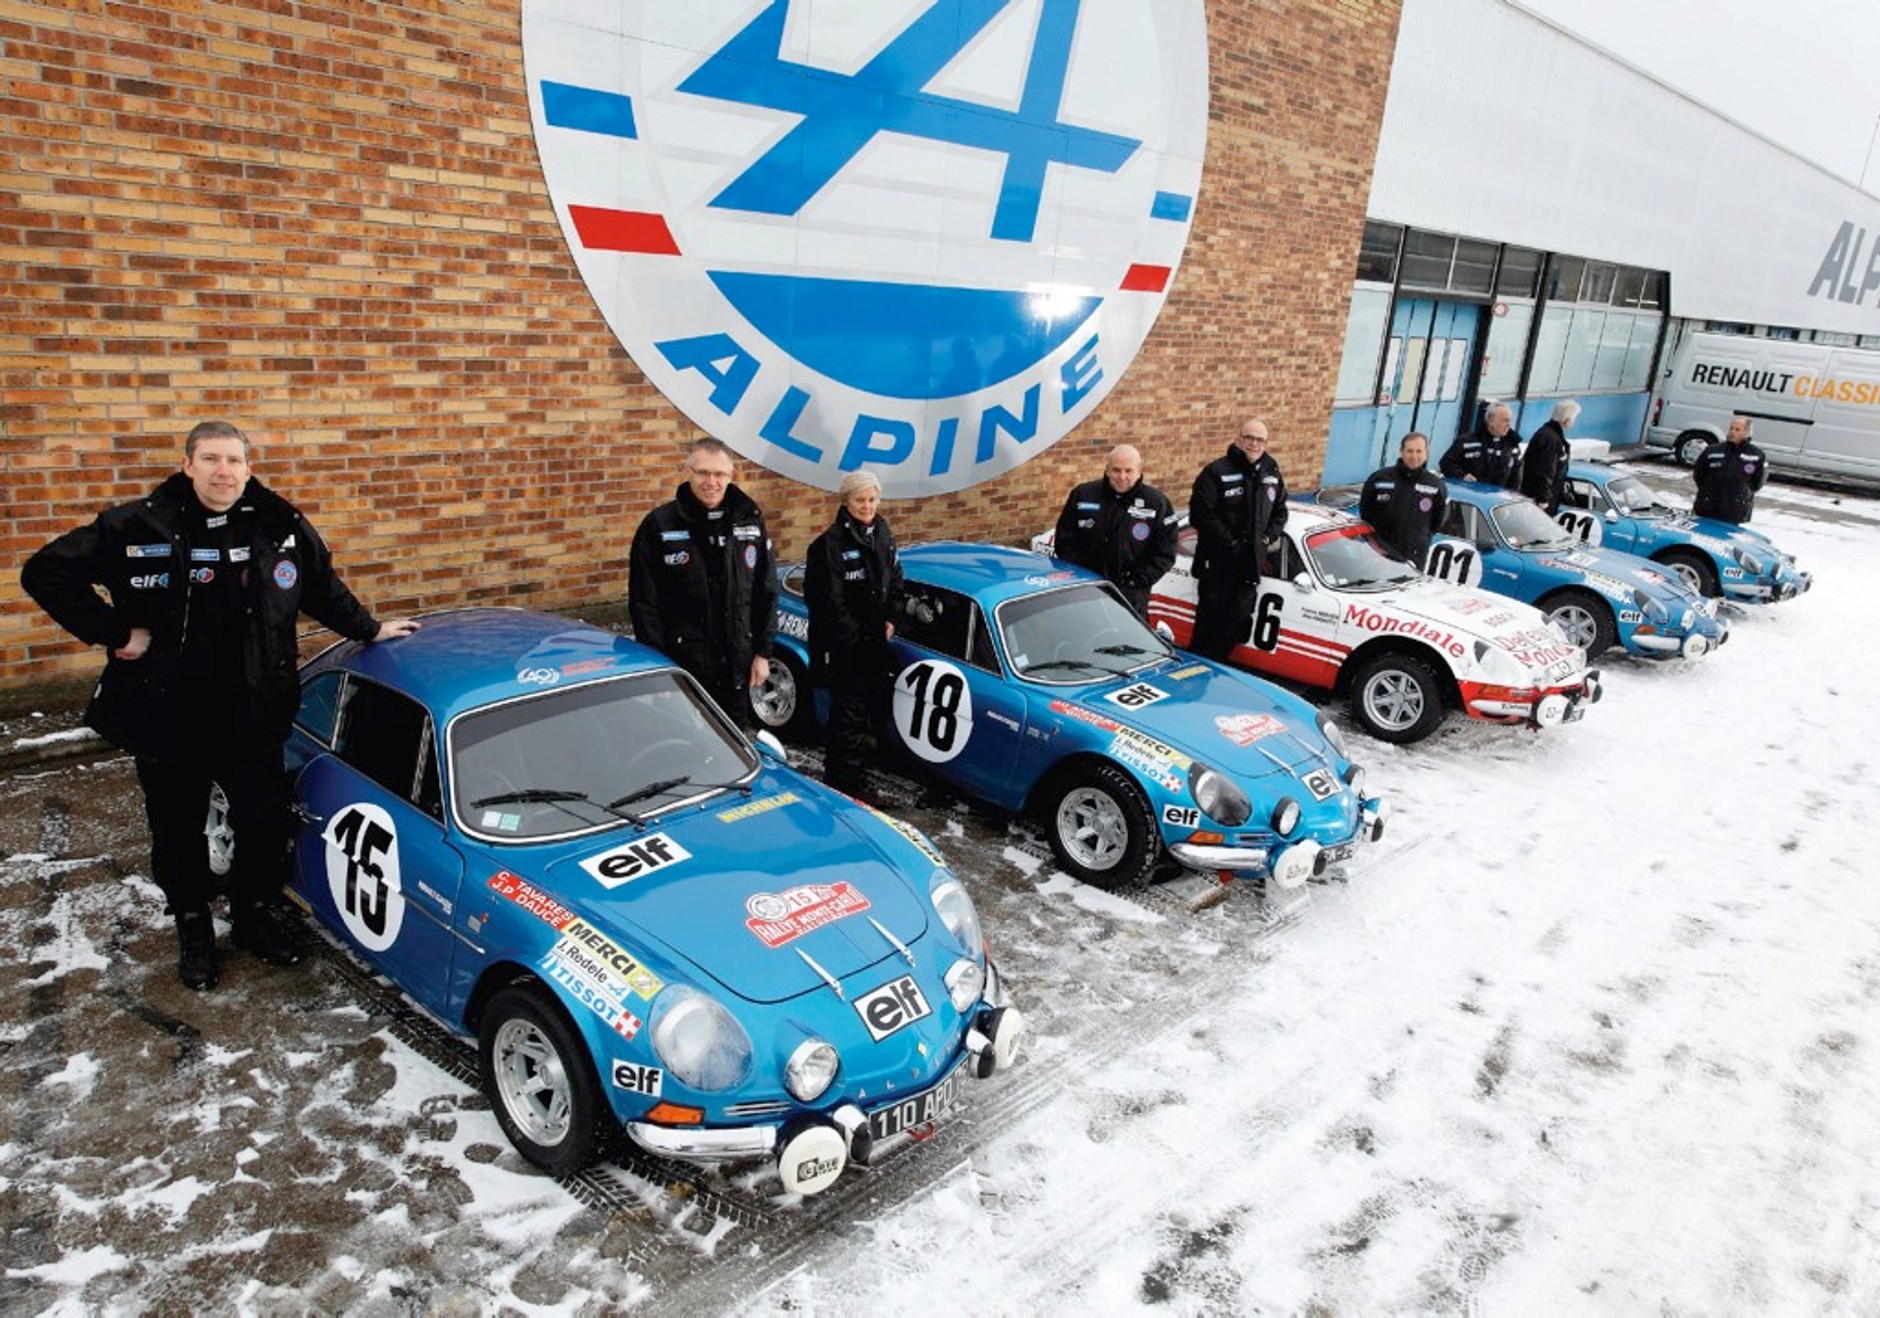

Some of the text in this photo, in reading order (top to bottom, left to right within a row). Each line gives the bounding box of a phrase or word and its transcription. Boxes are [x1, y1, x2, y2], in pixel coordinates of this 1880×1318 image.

[1691, 363, 1793, 393] RENAULT
[653, 332, 1104, 476] ALPINE
[130, 574, 159, 588] elf
[1343, 604, 1465, 658] Mondiale
[1621, 612, 1641, 621] elf
[905, 663, 963, 751] 18
[1117, 685, 1160, 706] elf
[1120, 727, 1172, 756] MERCI
[1121, 752, 1166, 782] TISSOT
[1166, 808, 1198, 826] elf
[334, 808, 394, 936] 15
[598, 837, 675, 878] elf
[515, 894, 562, 927] DAUCE
[517, 882, 574, 922] TAVARES
[789, 892, 811, 906] 15
[568, 922, 637, 976] MERCI
[556, 967, 619, 1021] TISSOT
[866, 979, 923, 1031] elf
[614, 1064, 660, 1094] elf
[878, 1100, 916, 1137] 110
